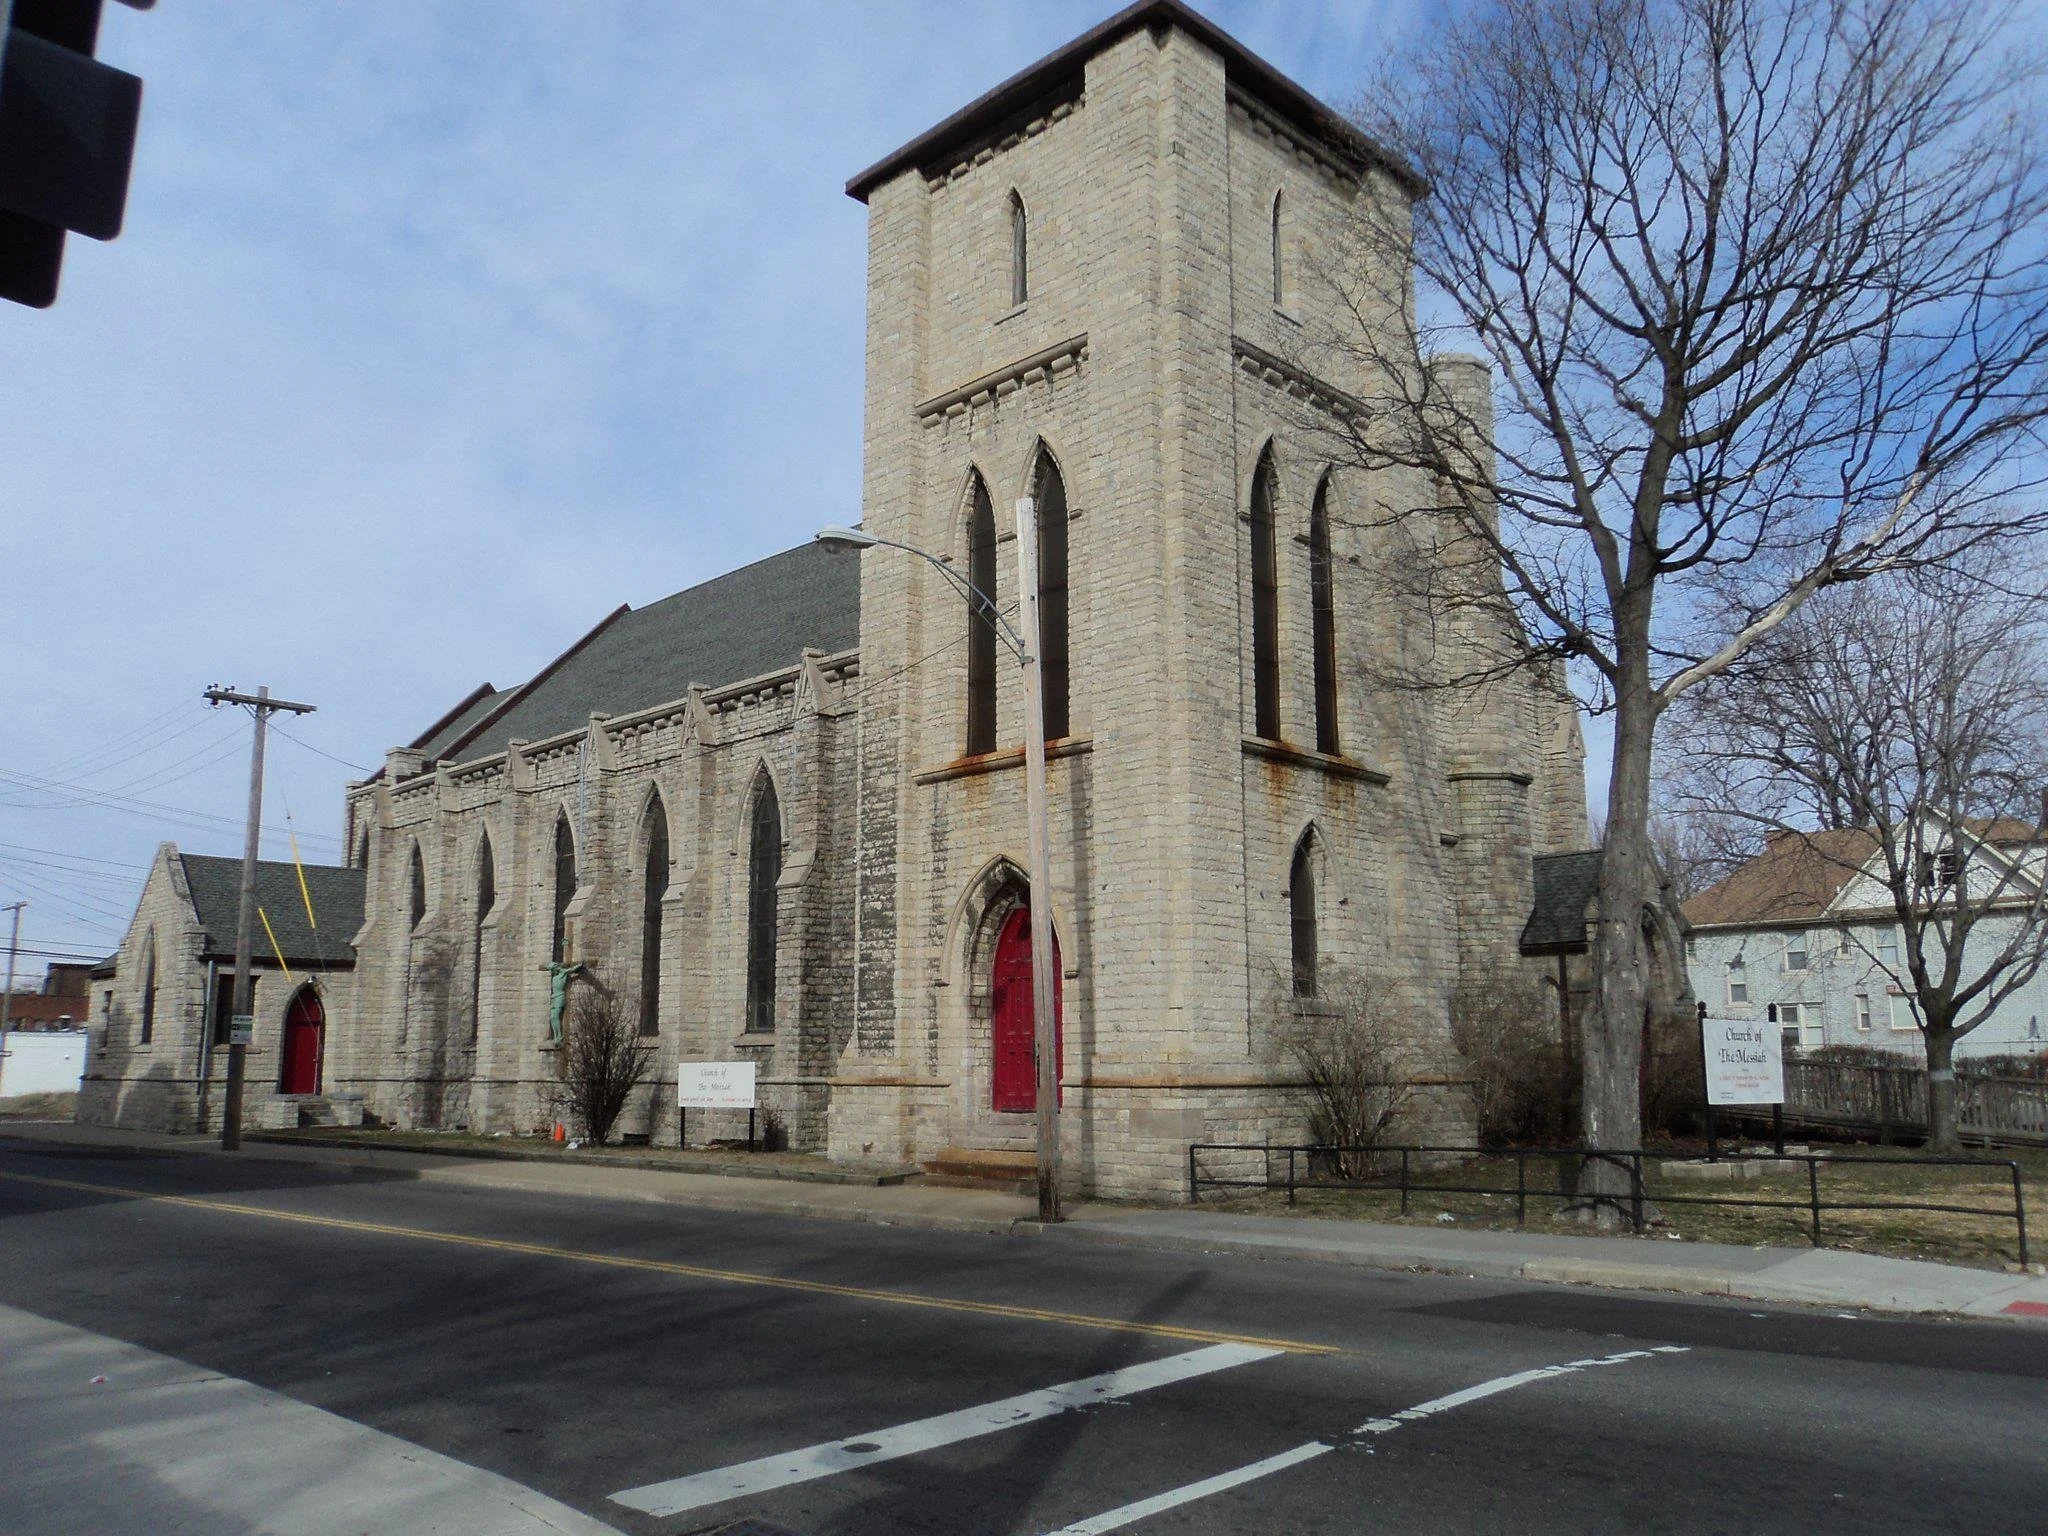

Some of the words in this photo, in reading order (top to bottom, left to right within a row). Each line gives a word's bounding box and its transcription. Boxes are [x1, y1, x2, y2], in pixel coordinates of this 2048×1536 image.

[1725, 1027, 1752, 1042] Church
[1755, 1027, 1763, 1044] of
[1718, 1047, 1734, 1063] The
[1736, 1047, 1767, 1063] Messiah
